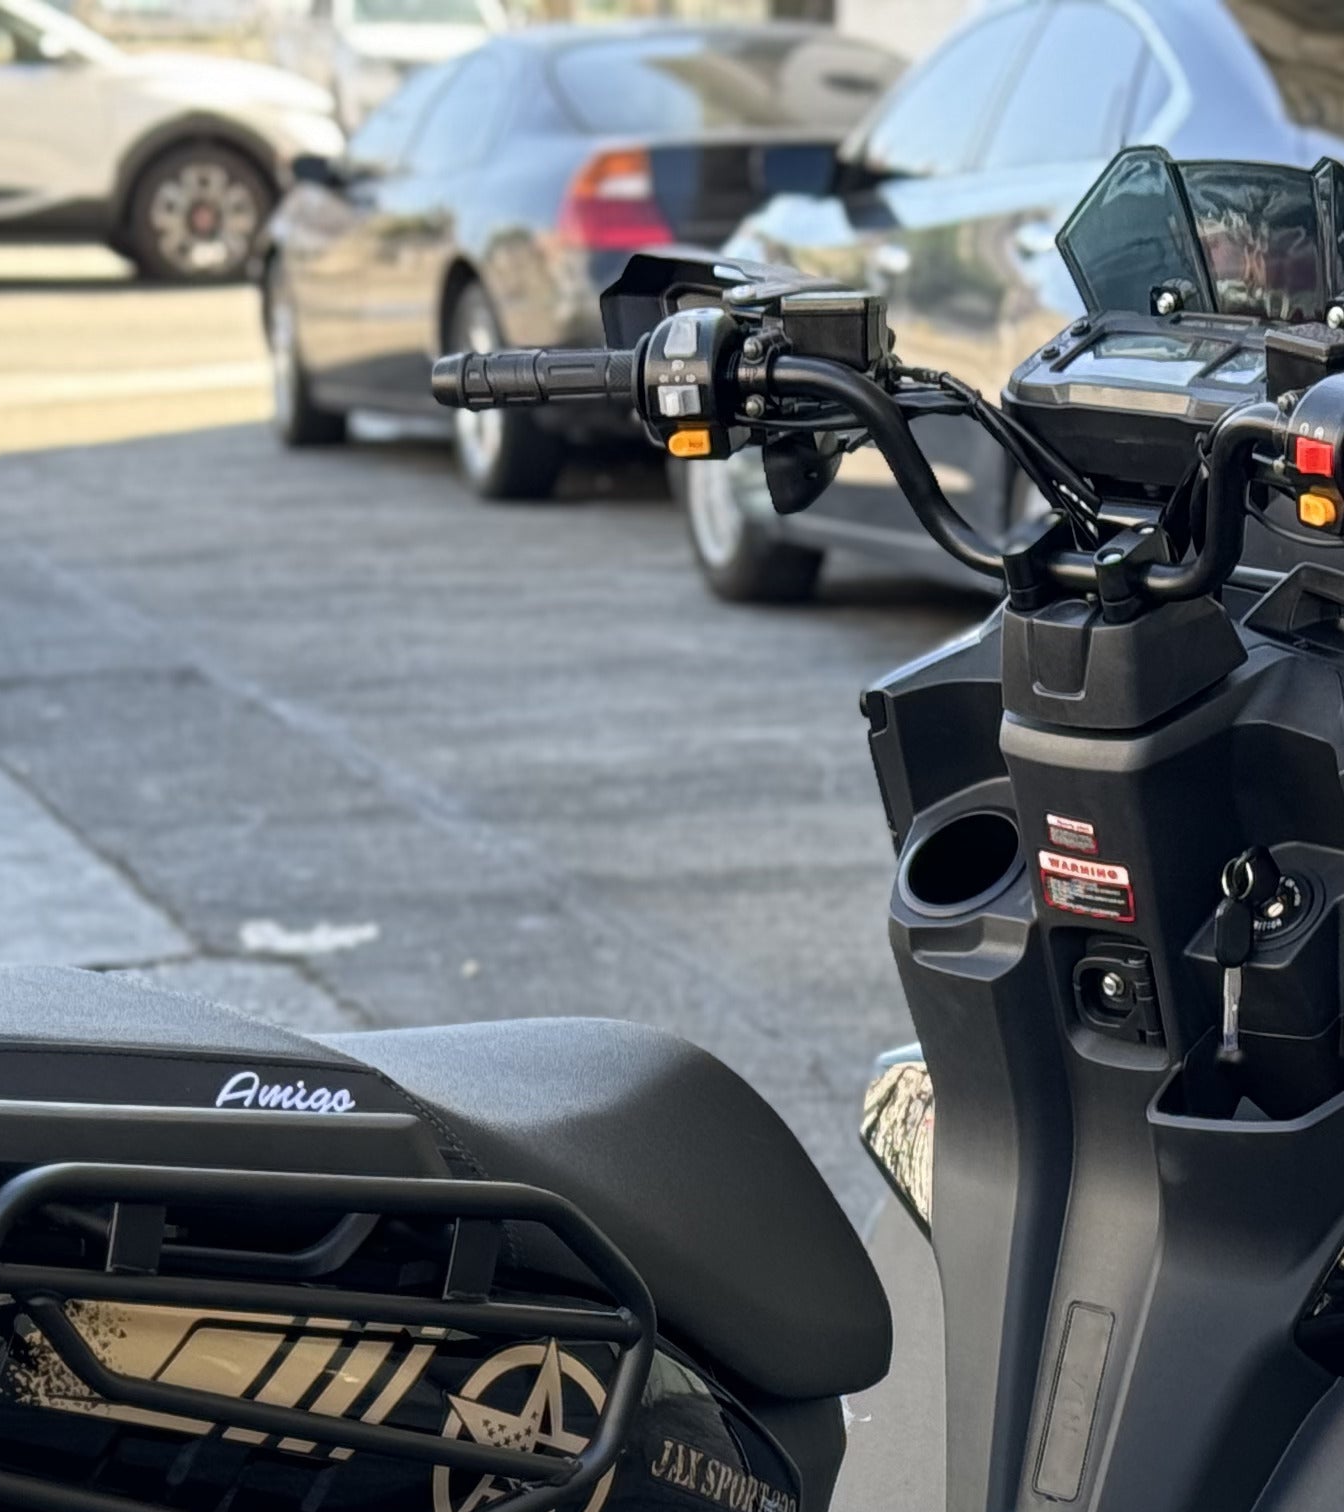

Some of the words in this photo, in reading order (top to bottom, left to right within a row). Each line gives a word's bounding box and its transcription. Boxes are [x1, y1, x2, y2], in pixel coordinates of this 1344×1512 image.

[1048, 857, 1118, 881] WARNING
[215, 1071, 356, 1113] Amigo
[651, 1440, 705, 1490] JAX
